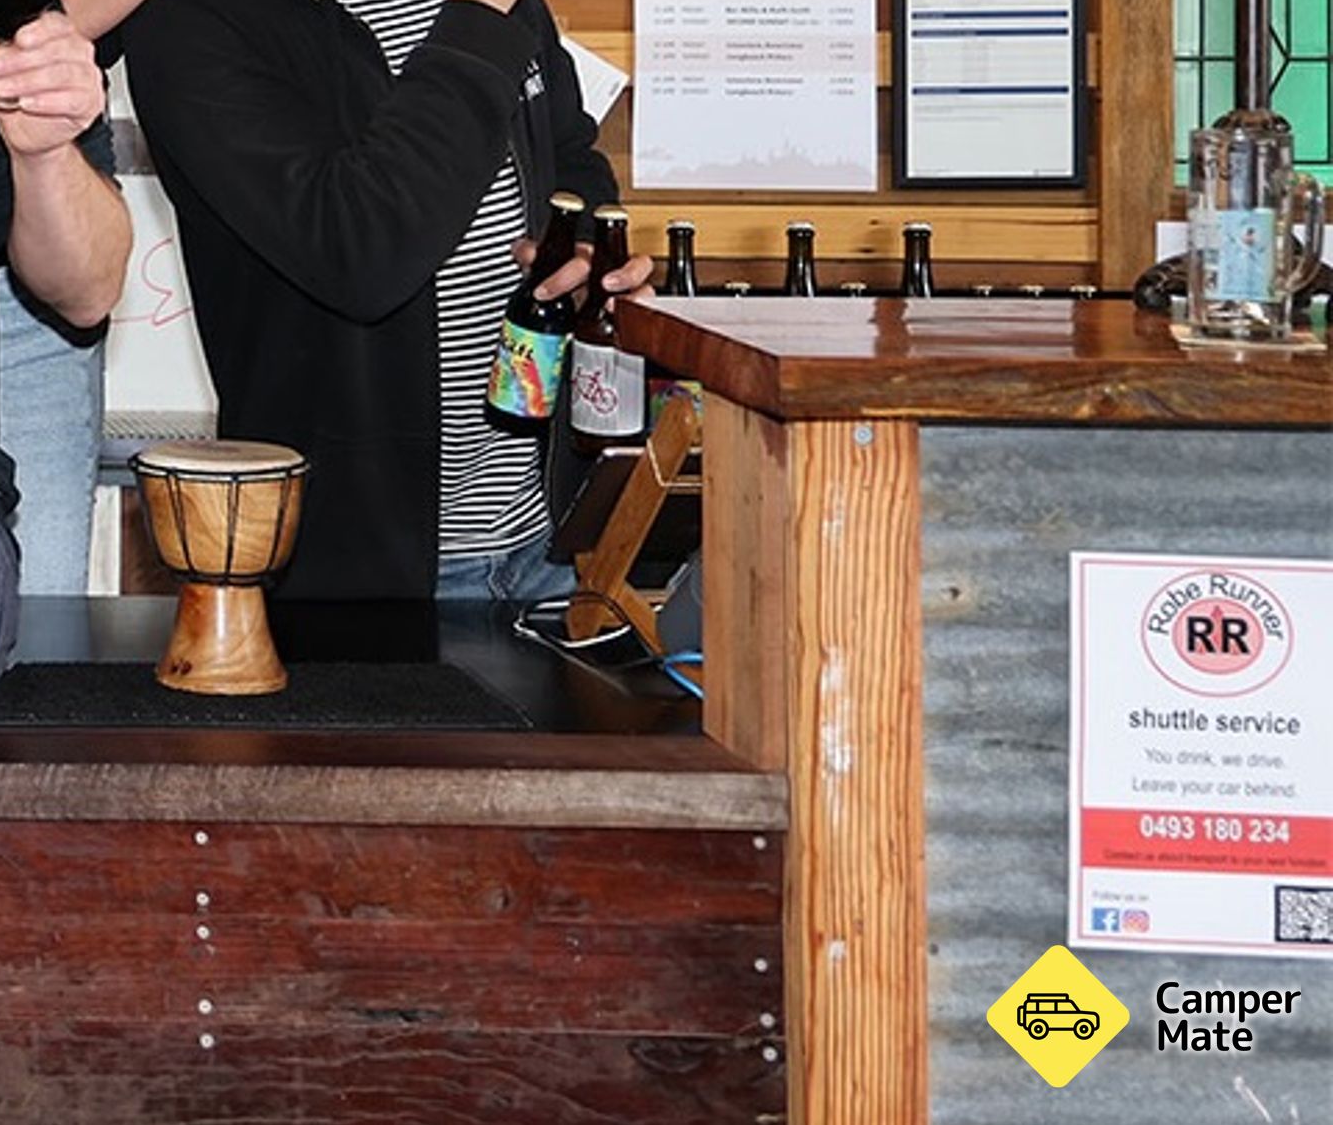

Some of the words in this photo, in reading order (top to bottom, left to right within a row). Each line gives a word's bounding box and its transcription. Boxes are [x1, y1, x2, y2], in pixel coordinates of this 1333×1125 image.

[1148, 581, 1203, 637] Robe
[1210, 574, 1284, 641] Runner
[1186, 616, 1249, 655] RR
[1129, 708, 1209, 732] shuttle
[1216, 712, 1301, 736] service
[1145, 749, 1173, 765] You
[1221, 755, 1241, 767] we
[1132, 778, 1177, 793] Leave
[1182, 781, 1212, 796] your
[1219, 782, 1241, 795] car
[1140, 814, 1195, 839] 0493
[1248, 820, 1290, 843] 234
